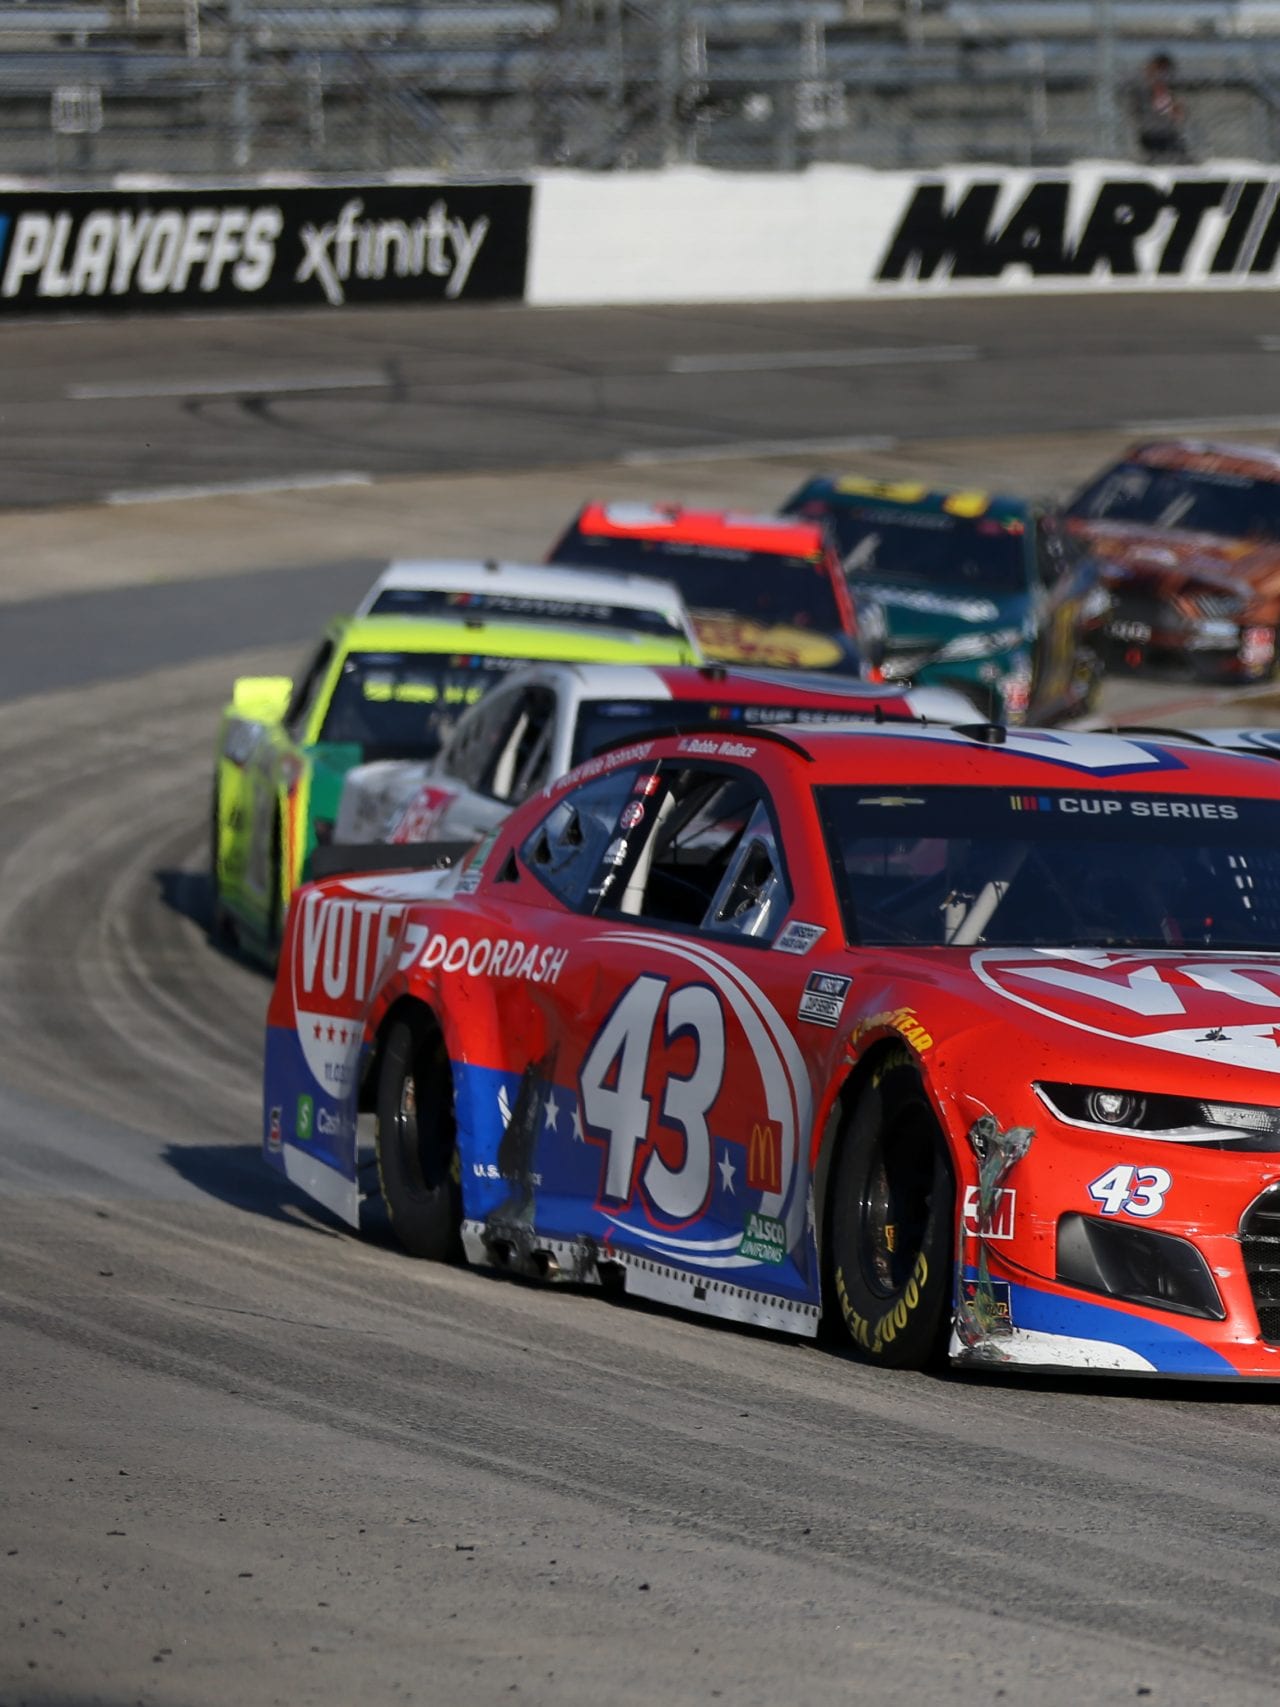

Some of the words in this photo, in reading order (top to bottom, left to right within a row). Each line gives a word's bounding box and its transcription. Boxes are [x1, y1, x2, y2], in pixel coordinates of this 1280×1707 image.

[2, 205, 283, 298] PLAYOFFS
[295, 197, 490, 306] xfinity
[1058, 796, 1123, 816] CUP
[1131, 800, 1240, 821] SERIES
[419, 933, 569, 985] DOORDASH
[578, 971, 728, 1222] 43
[1088, 1164, 1173, 1217] 43
[741, 1239, 784, 1263] UNIFORMS
[747, 1213, 785, 1245] ALSCO
